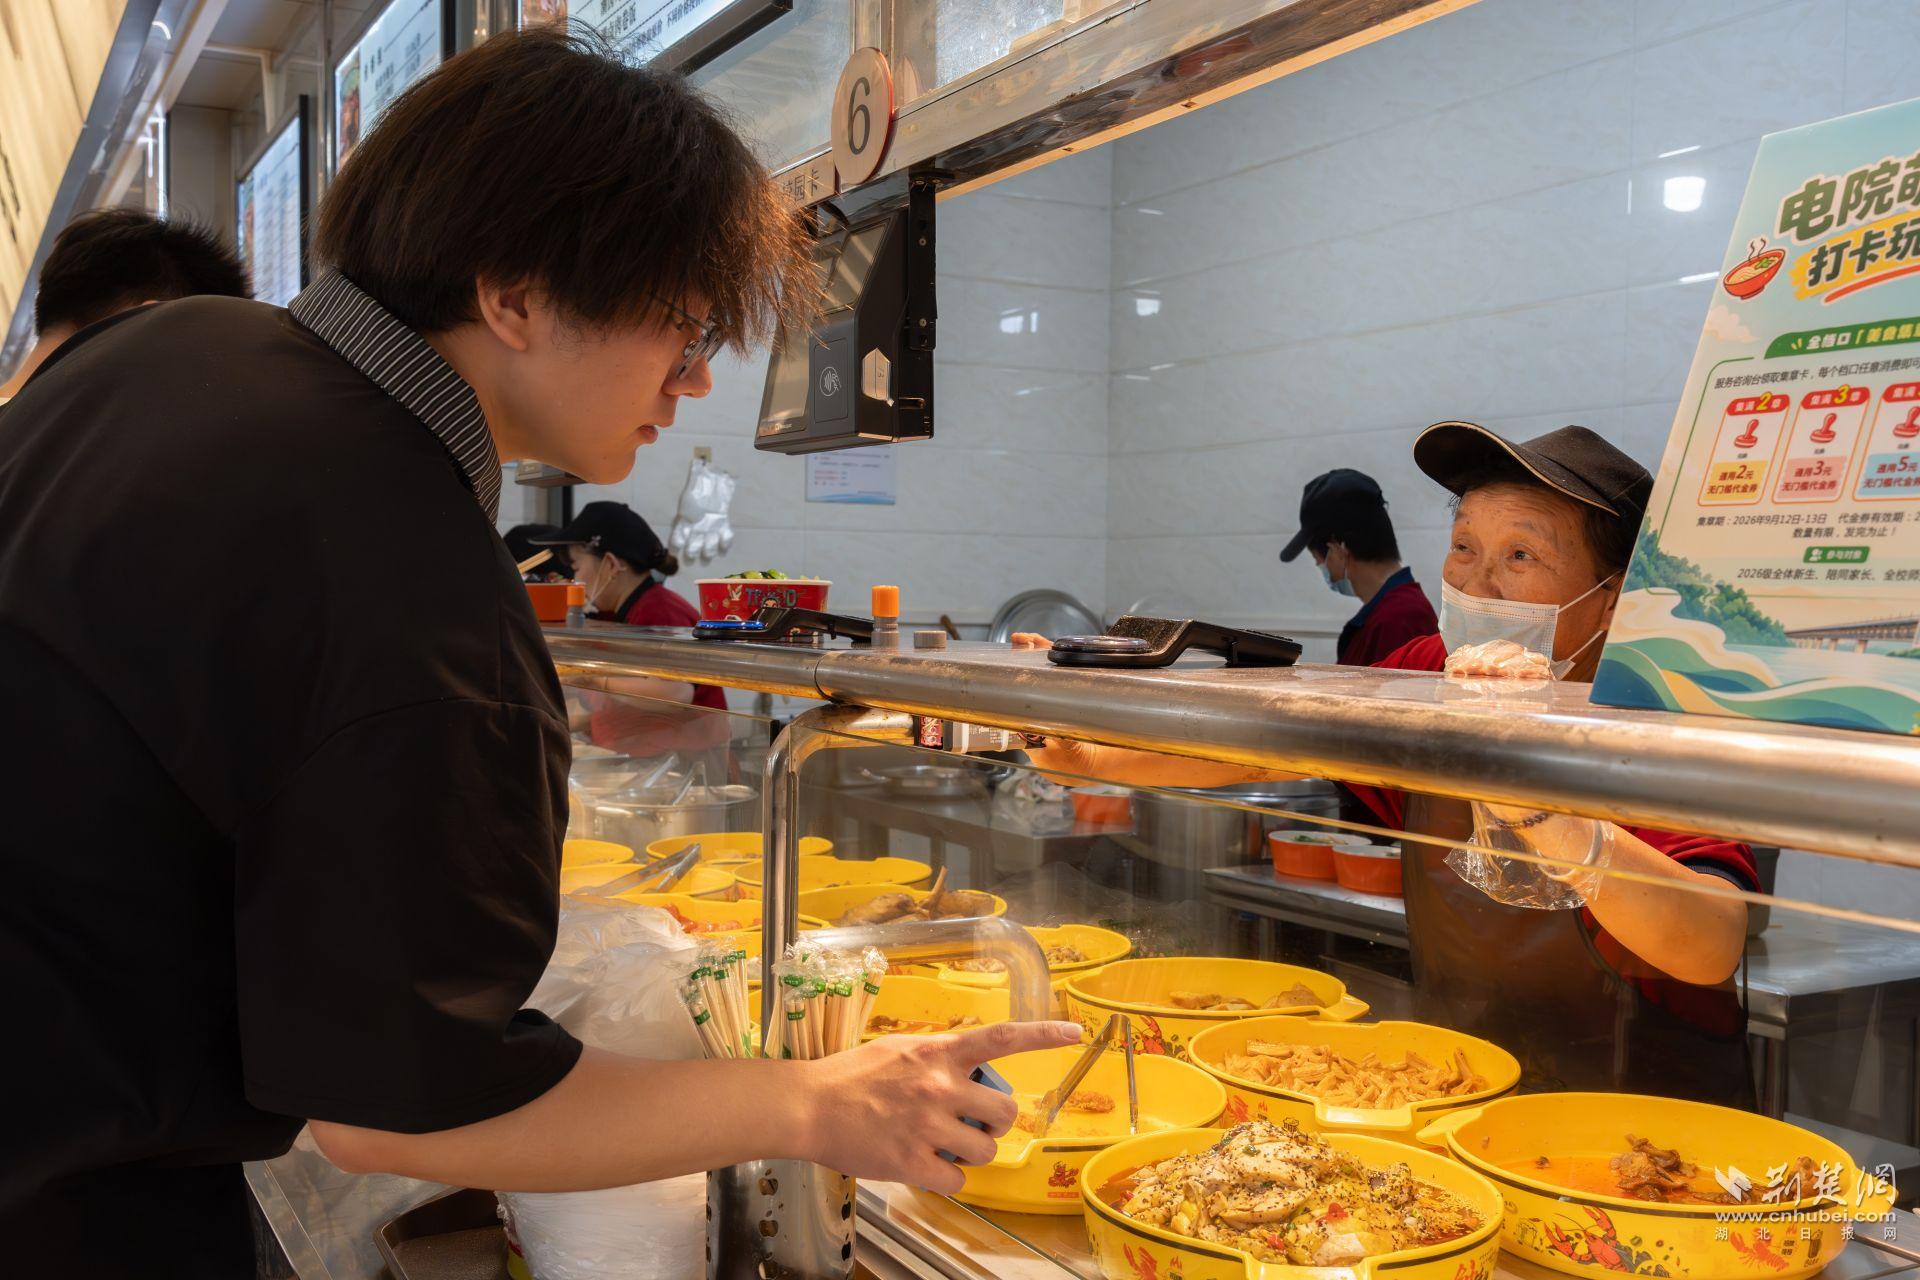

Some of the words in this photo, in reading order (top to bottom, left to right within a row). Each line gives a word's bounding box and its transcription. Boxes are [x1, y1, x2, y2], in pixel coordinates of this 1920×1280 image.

[848, 77, 870, 155] 6
[1892, 386, 1920, 399] 集满
[1737, 567, 1920, 582] 2026级全体新生、陪同家长、全校师
